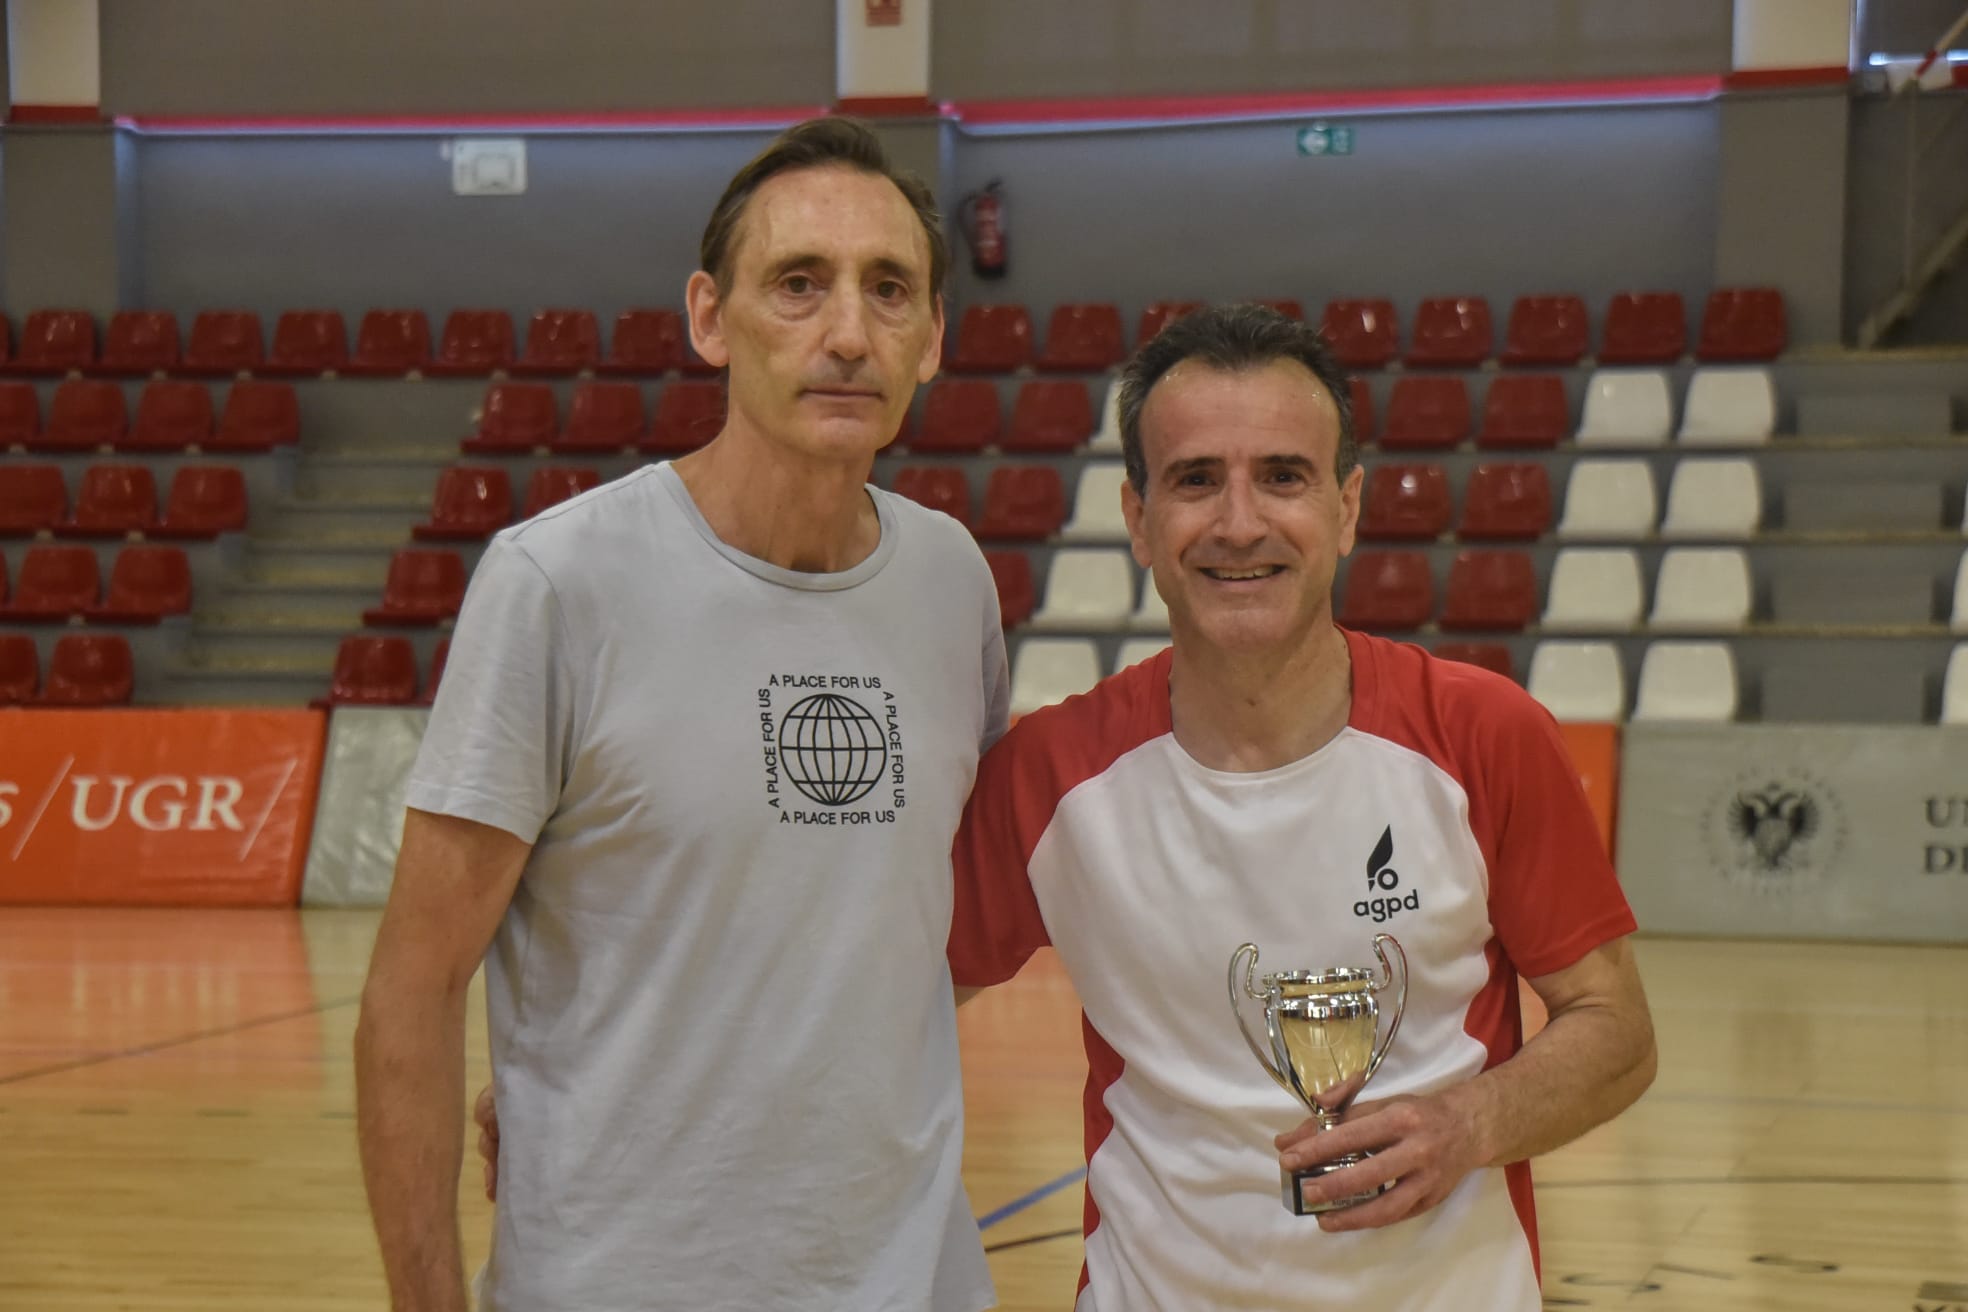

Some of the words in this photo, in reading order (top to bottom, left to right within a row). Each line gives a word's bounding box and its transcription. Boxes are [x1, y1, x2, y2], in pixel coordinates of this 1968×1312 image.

[769, 674, 780, 687] A
[783, 675, 827, 688] PLACE
[831, 676, 860, 688] FOR
[863, 677, 881, 689] US
[883, 691, 895, 701] A
[758, 688, 772, 708] US
[761, 712, 776, 743] FOR
[885, 704, 902, 750] PLACE
[764, 746, 779, 793] PLACE
[890, 754, 904, 784] FOR
[71, 775, 245, 832] UGR
[768, 798, 780, 808] A
[893, 788, 905, 808] US
[1924, 796, 1968, 829] U
[780, 811, 790, 823] A
[794, 811, 836, 825] PLACE
[841, 811, 871, 825] FOR
[875, 810, 895, 823] US
[1353, 889, 1419, 923] agpd
